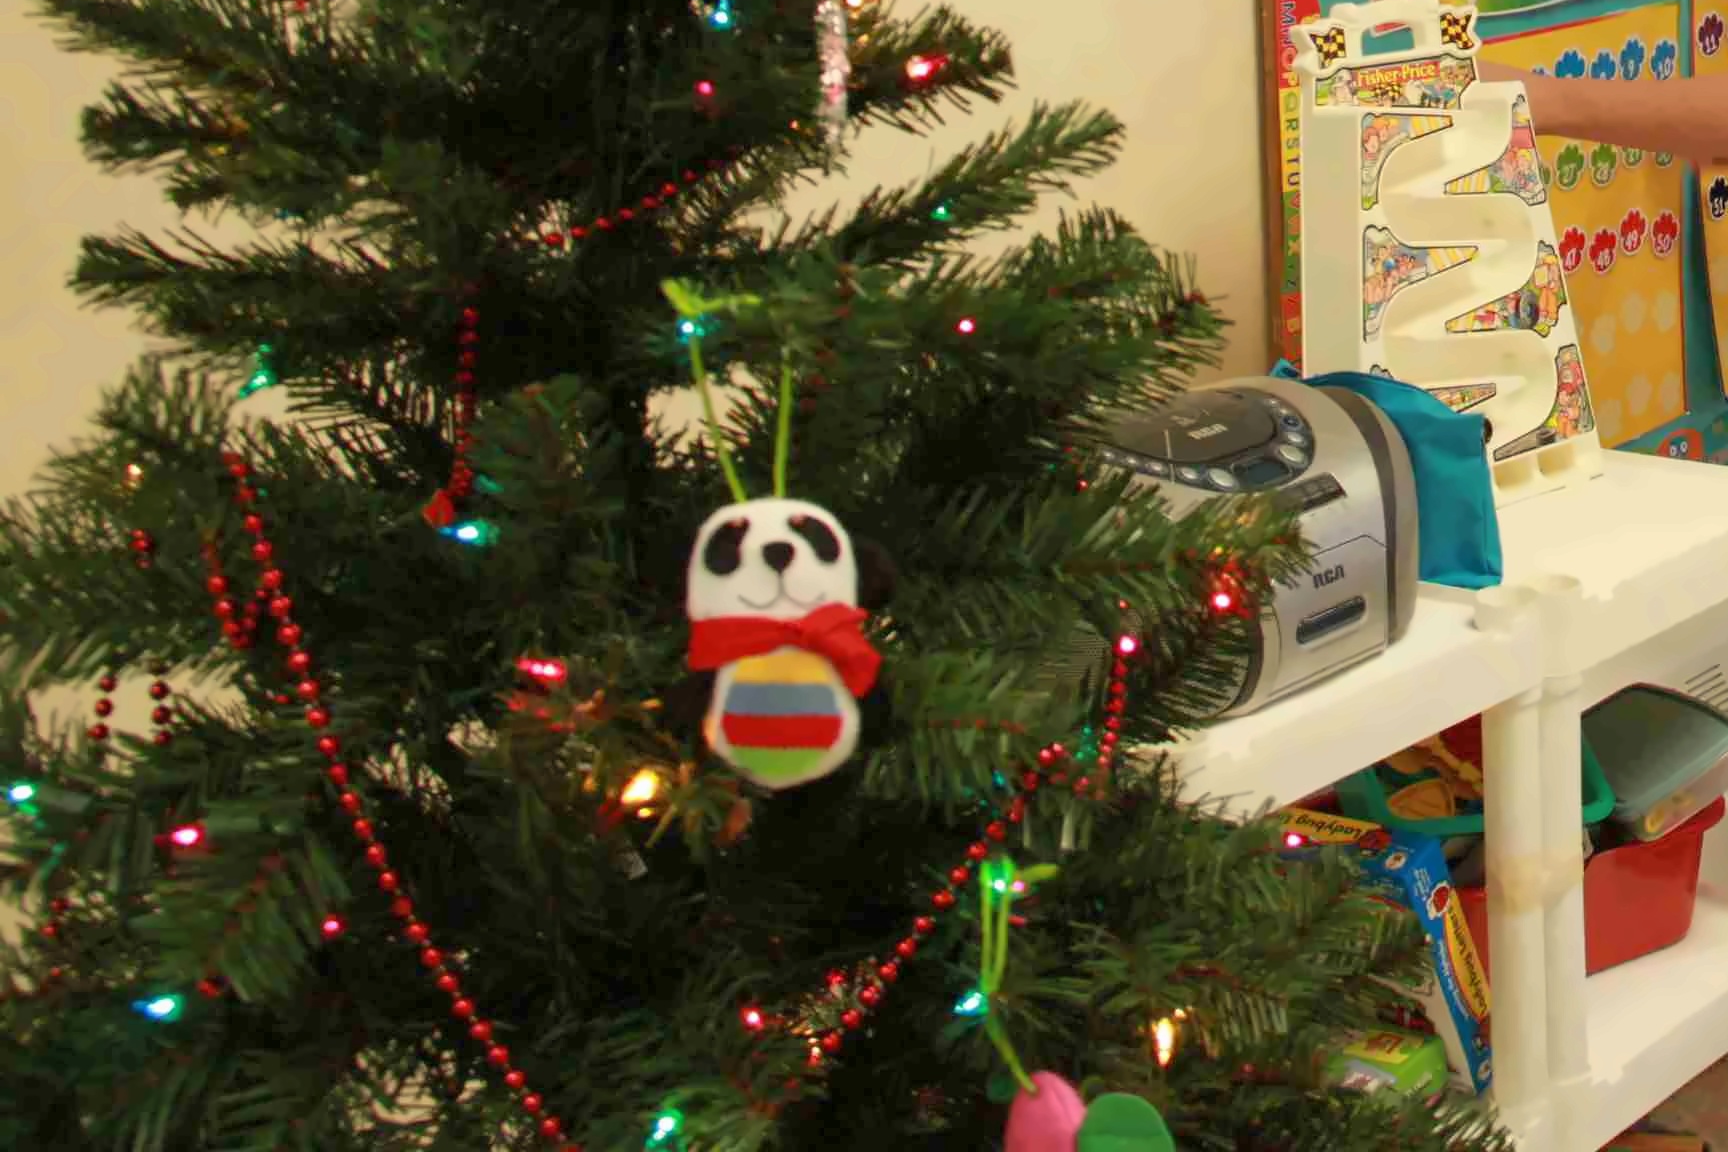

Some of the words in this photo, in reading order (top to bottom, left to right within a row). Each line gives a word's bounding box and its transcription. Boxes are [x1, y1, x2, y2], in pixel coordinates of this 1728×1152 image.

[1704, 33, 1717, 53] 11
[1359, 62, 1436, 87] Fisher-Price
[1627, 59, 1634, 77] 9
[1713, 197, 1724, 216] 51
[1625, 229, 1639, 249] 49
[1656, 233, 1672, 252] 50
[1312, 564, 1345, 589] RCA
[1296, 813, 1365, 841] Ladybug
